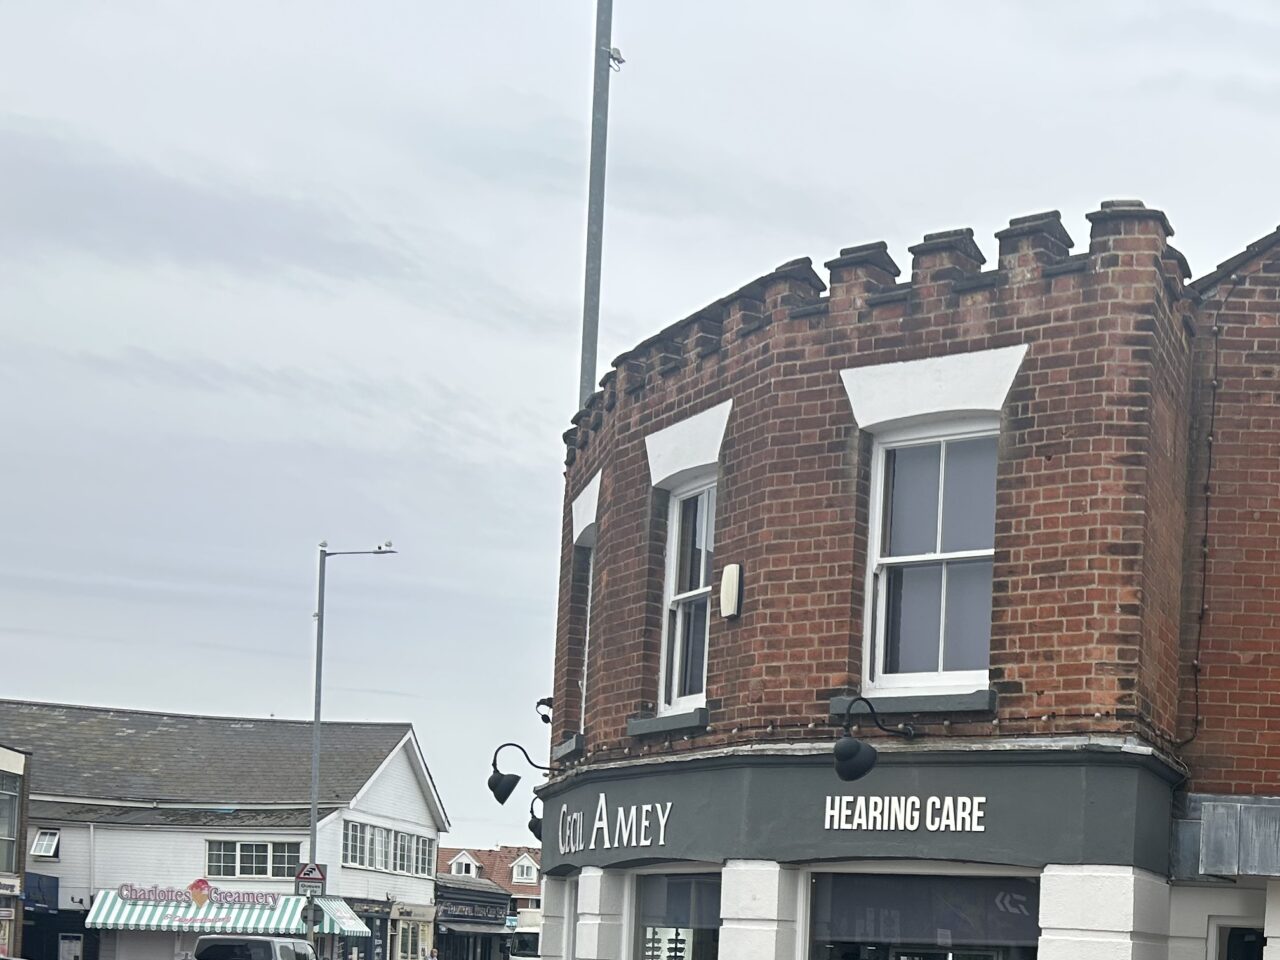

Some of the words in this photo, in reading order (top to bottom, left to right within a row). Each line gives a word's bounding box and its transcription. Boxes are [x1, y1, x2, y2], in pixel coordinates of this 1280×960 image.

[589, 792, 673, 850] AMEY
[825, 795, 921, 831] HEARING
[926, 796, 986, 832] CARE
[117, 883, 192, 901] Charlottes
[208, 887, 281, 908] Creamery
